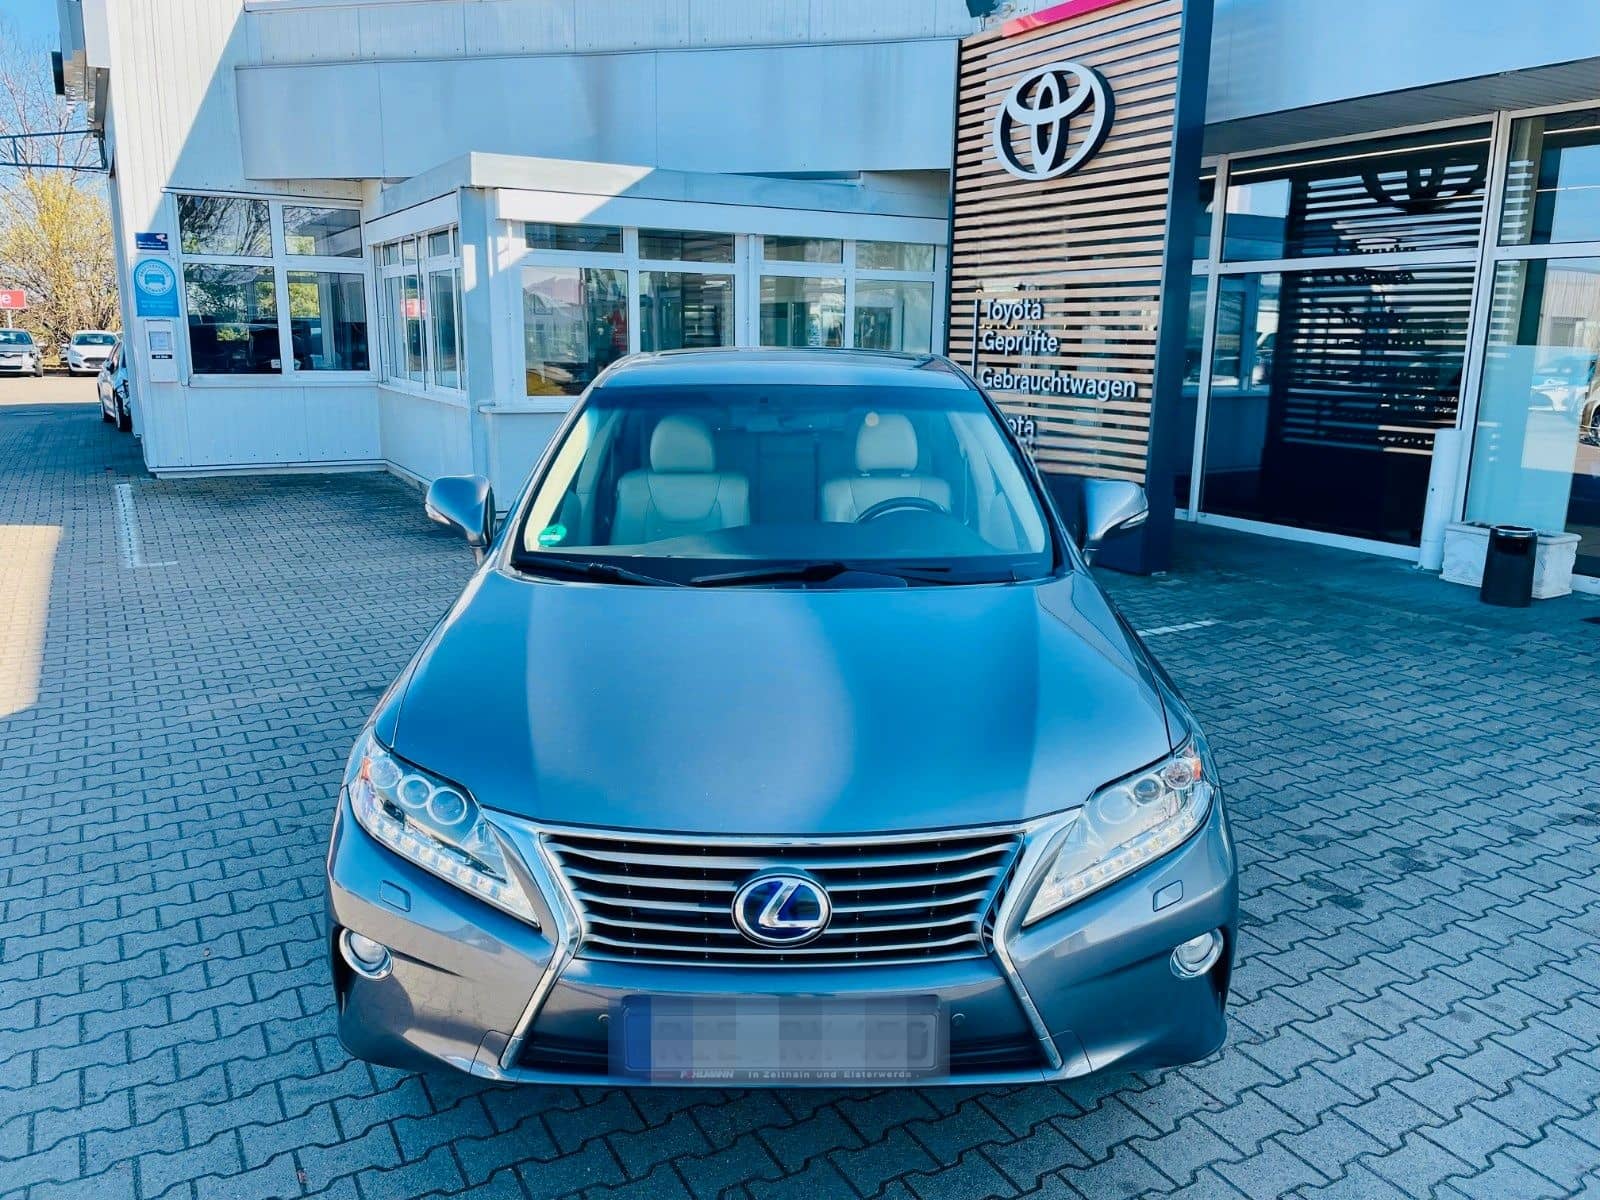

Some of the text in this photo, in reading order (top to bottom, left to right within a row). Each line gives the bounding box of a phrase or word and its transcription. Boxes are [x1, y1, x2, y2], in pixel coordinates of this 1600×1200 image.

[985, 297, 1042, 325] Toyota
[982, 329, 1059, 356] Geprüfte
[980, 367, 1137, 402] Gebrauchtwagen
[816, 1070, 837, 1079] und
